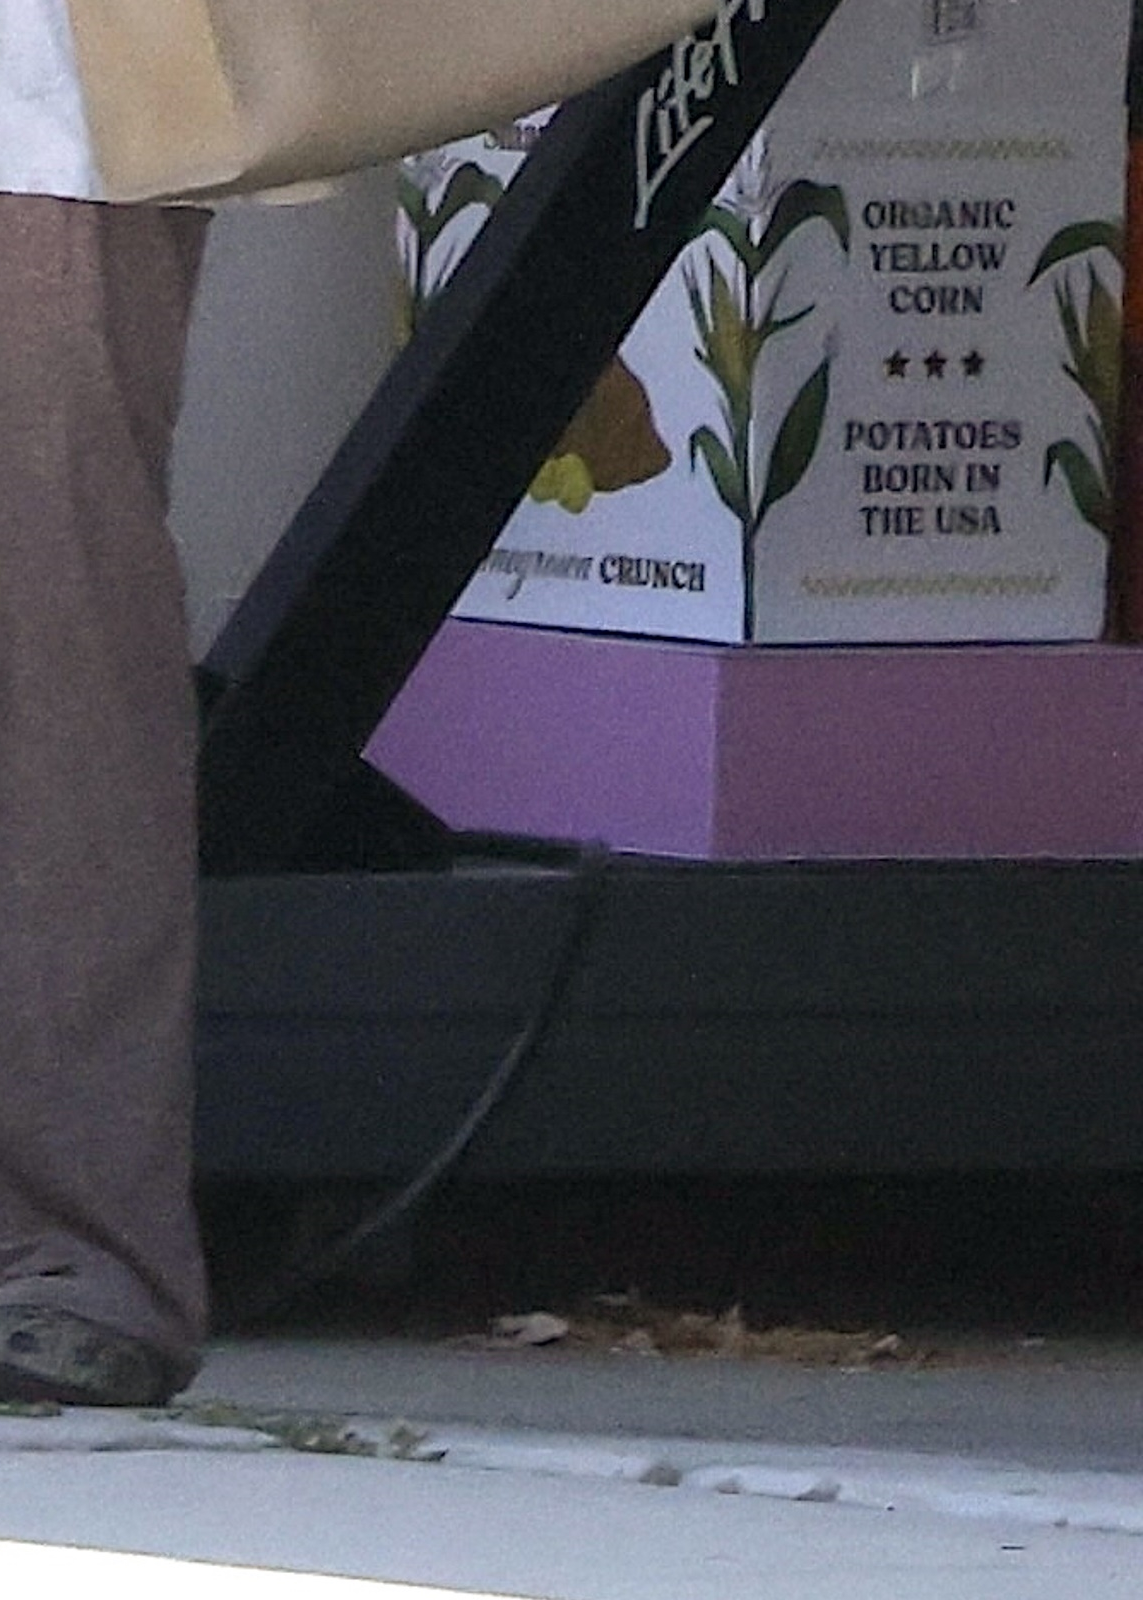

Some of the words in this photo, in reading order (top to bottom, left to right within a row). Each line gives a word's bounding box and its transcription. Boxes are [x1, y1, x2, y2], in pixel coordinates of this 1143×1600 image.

[863, 199, 1015, 230] ORGANIC
[870, 243, 1006, 272] YELLOW
[890, 286, 983, 314] CORN
[844, 420, 1021, 450] POTATOES
[864, 464, 955, 492] BORN
[966, 464, 1000, 491] IN
[859, 506, 924, 535] THE
[937, 506, 1001, 534] USA
[600, 555, 705, 592] CRUNCH
